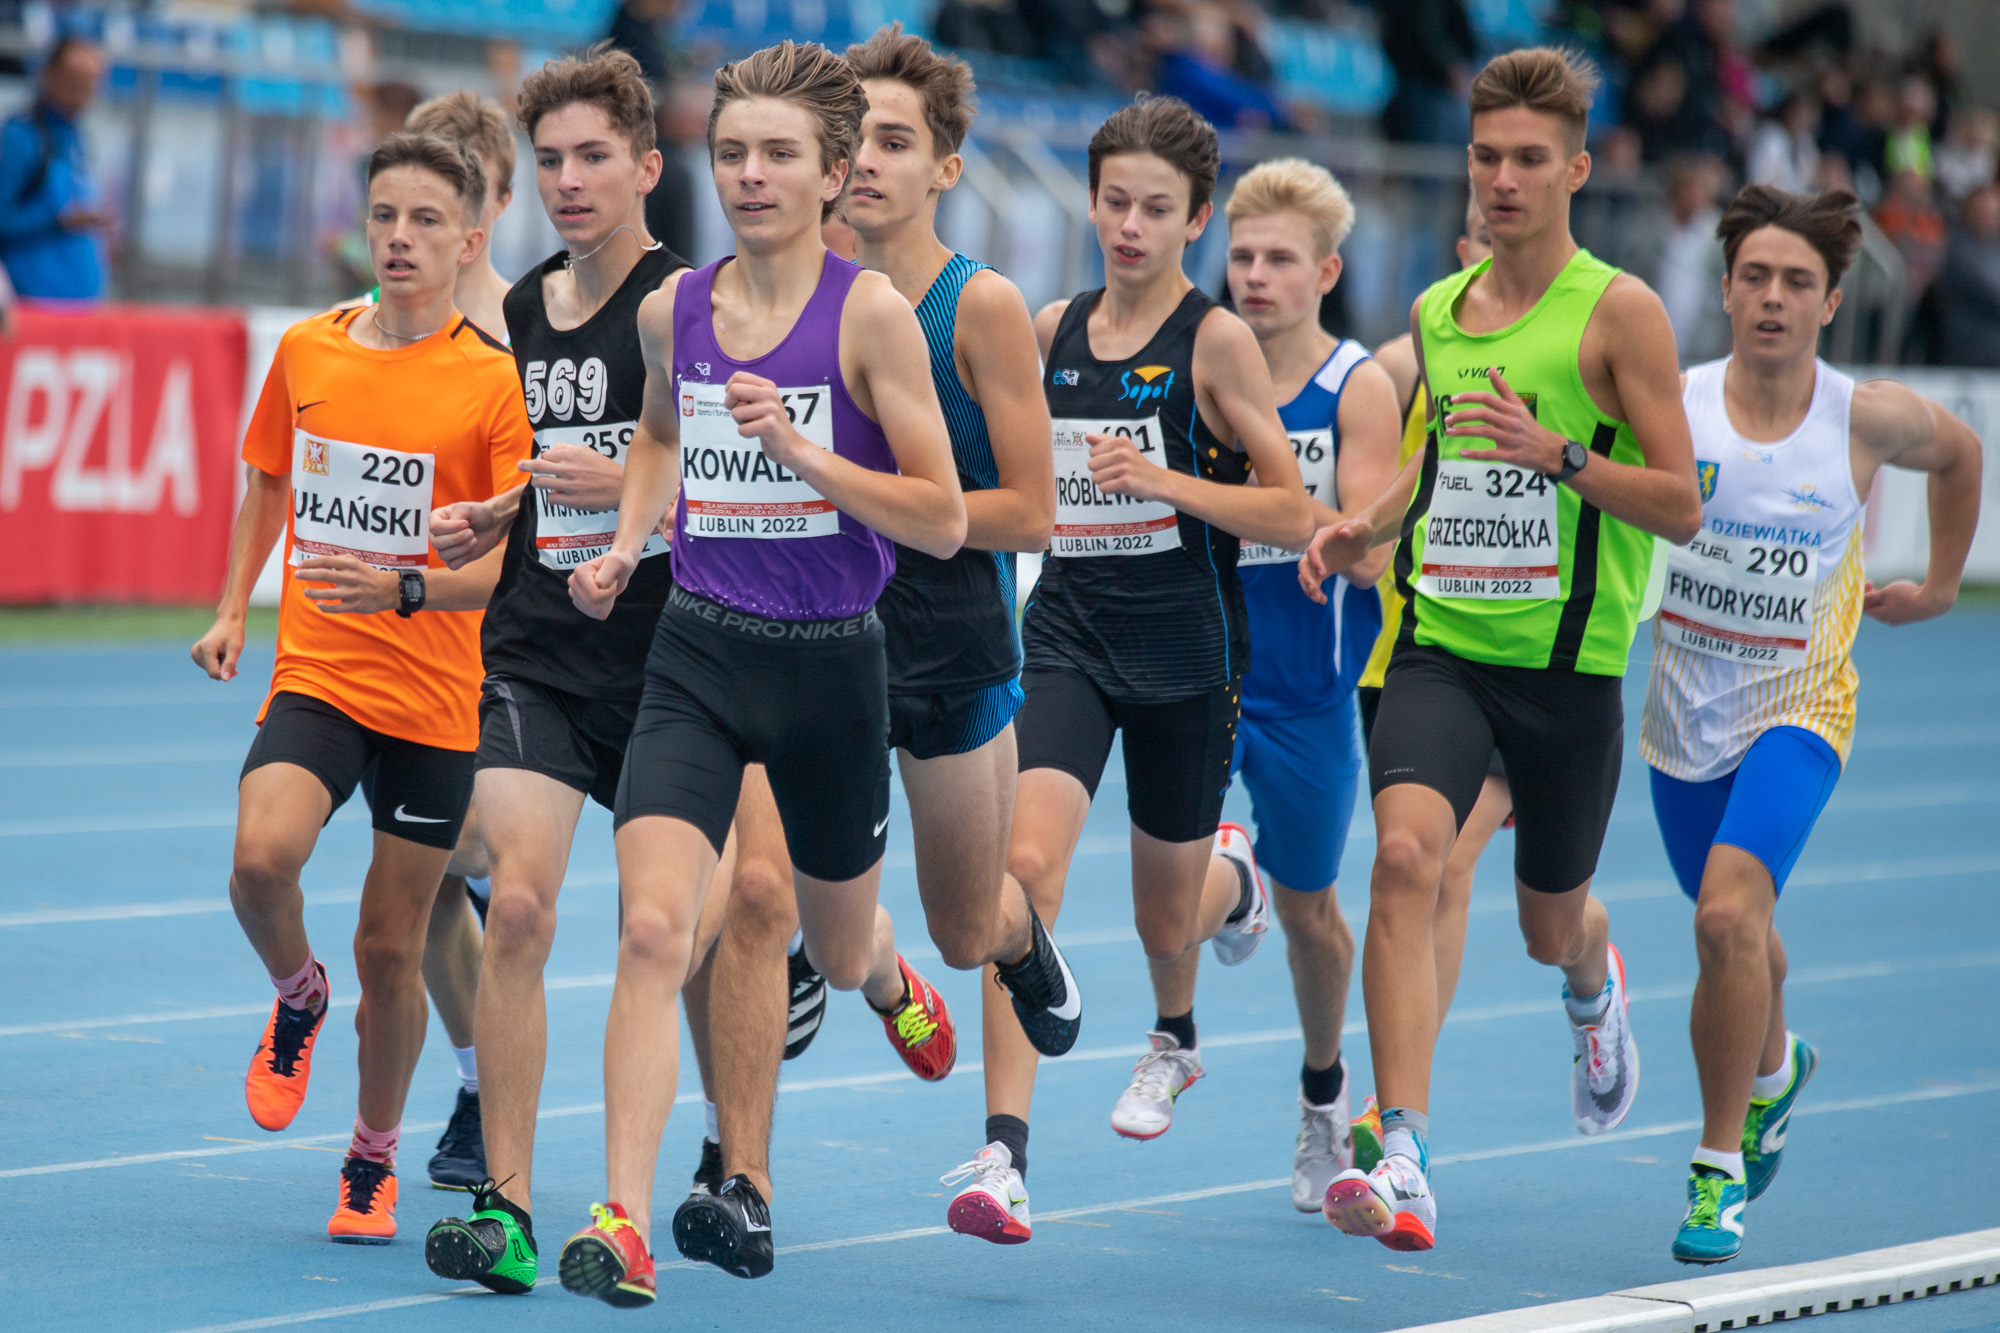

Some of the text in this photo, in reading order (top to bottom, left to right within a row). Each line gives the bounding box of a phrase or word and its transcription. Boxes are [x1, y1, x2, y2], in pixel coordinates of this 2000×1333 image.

[525, 357, 608, 424] 569
[1053, 369, 1080, 386] esa
[1118, 370, 1175, 410] Sopot
[0, 347, 199, 517] PZLA
[361, 452, 425, 487] 220
[1440, 469, 1547, 498] FUEL 324
[294, 488, 421, 537] UŁAŃSKI
[699, 517, 808, 533] LUBLIN 2022
[1060, 535, 1154, 552] LUBLIN 2022
[1428, 514, 1551, 549] GRZEGRZÓŁKA
[1711, 518, 1821, 548] DZIEWIĄTKA
[557, 547, 602, 565] LUBLIN
[1240, 546, 1272, 560] BLIN
[1690, 541, 1809, 578] FUEL 290
[1438, 578, 1533, 594] LUBLIN 2022
[1669, 572, 1807, 625] FRYDRYSIAK
[669, 587, 882, 640] NIKE PRO NIKE P
[1680, 630, 1733, 655] LUBLIN
[1737, 645, 1779, 661] 2022
